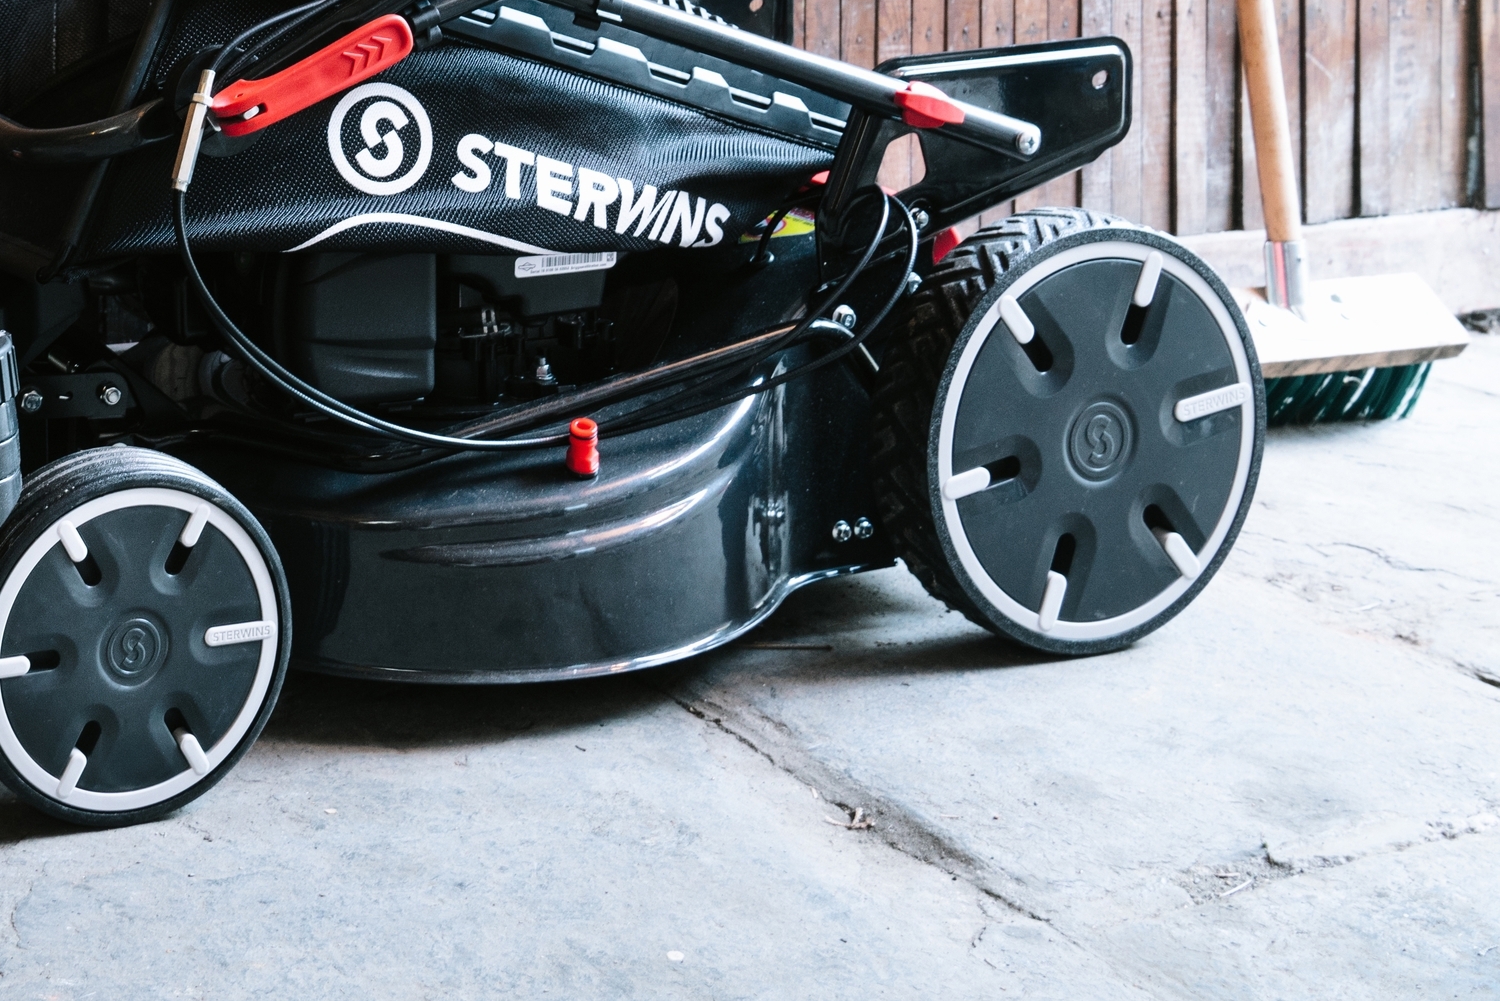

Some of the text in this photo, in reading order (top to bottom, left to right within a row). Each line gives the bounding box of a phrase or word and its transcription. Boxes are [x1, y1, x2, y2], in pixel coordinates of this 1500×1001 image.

[451, 133, 731, 248] STERWINS
[1183, 387, 1246, 416] STERWINS
[213, 625, 270, 642] STERWINS
